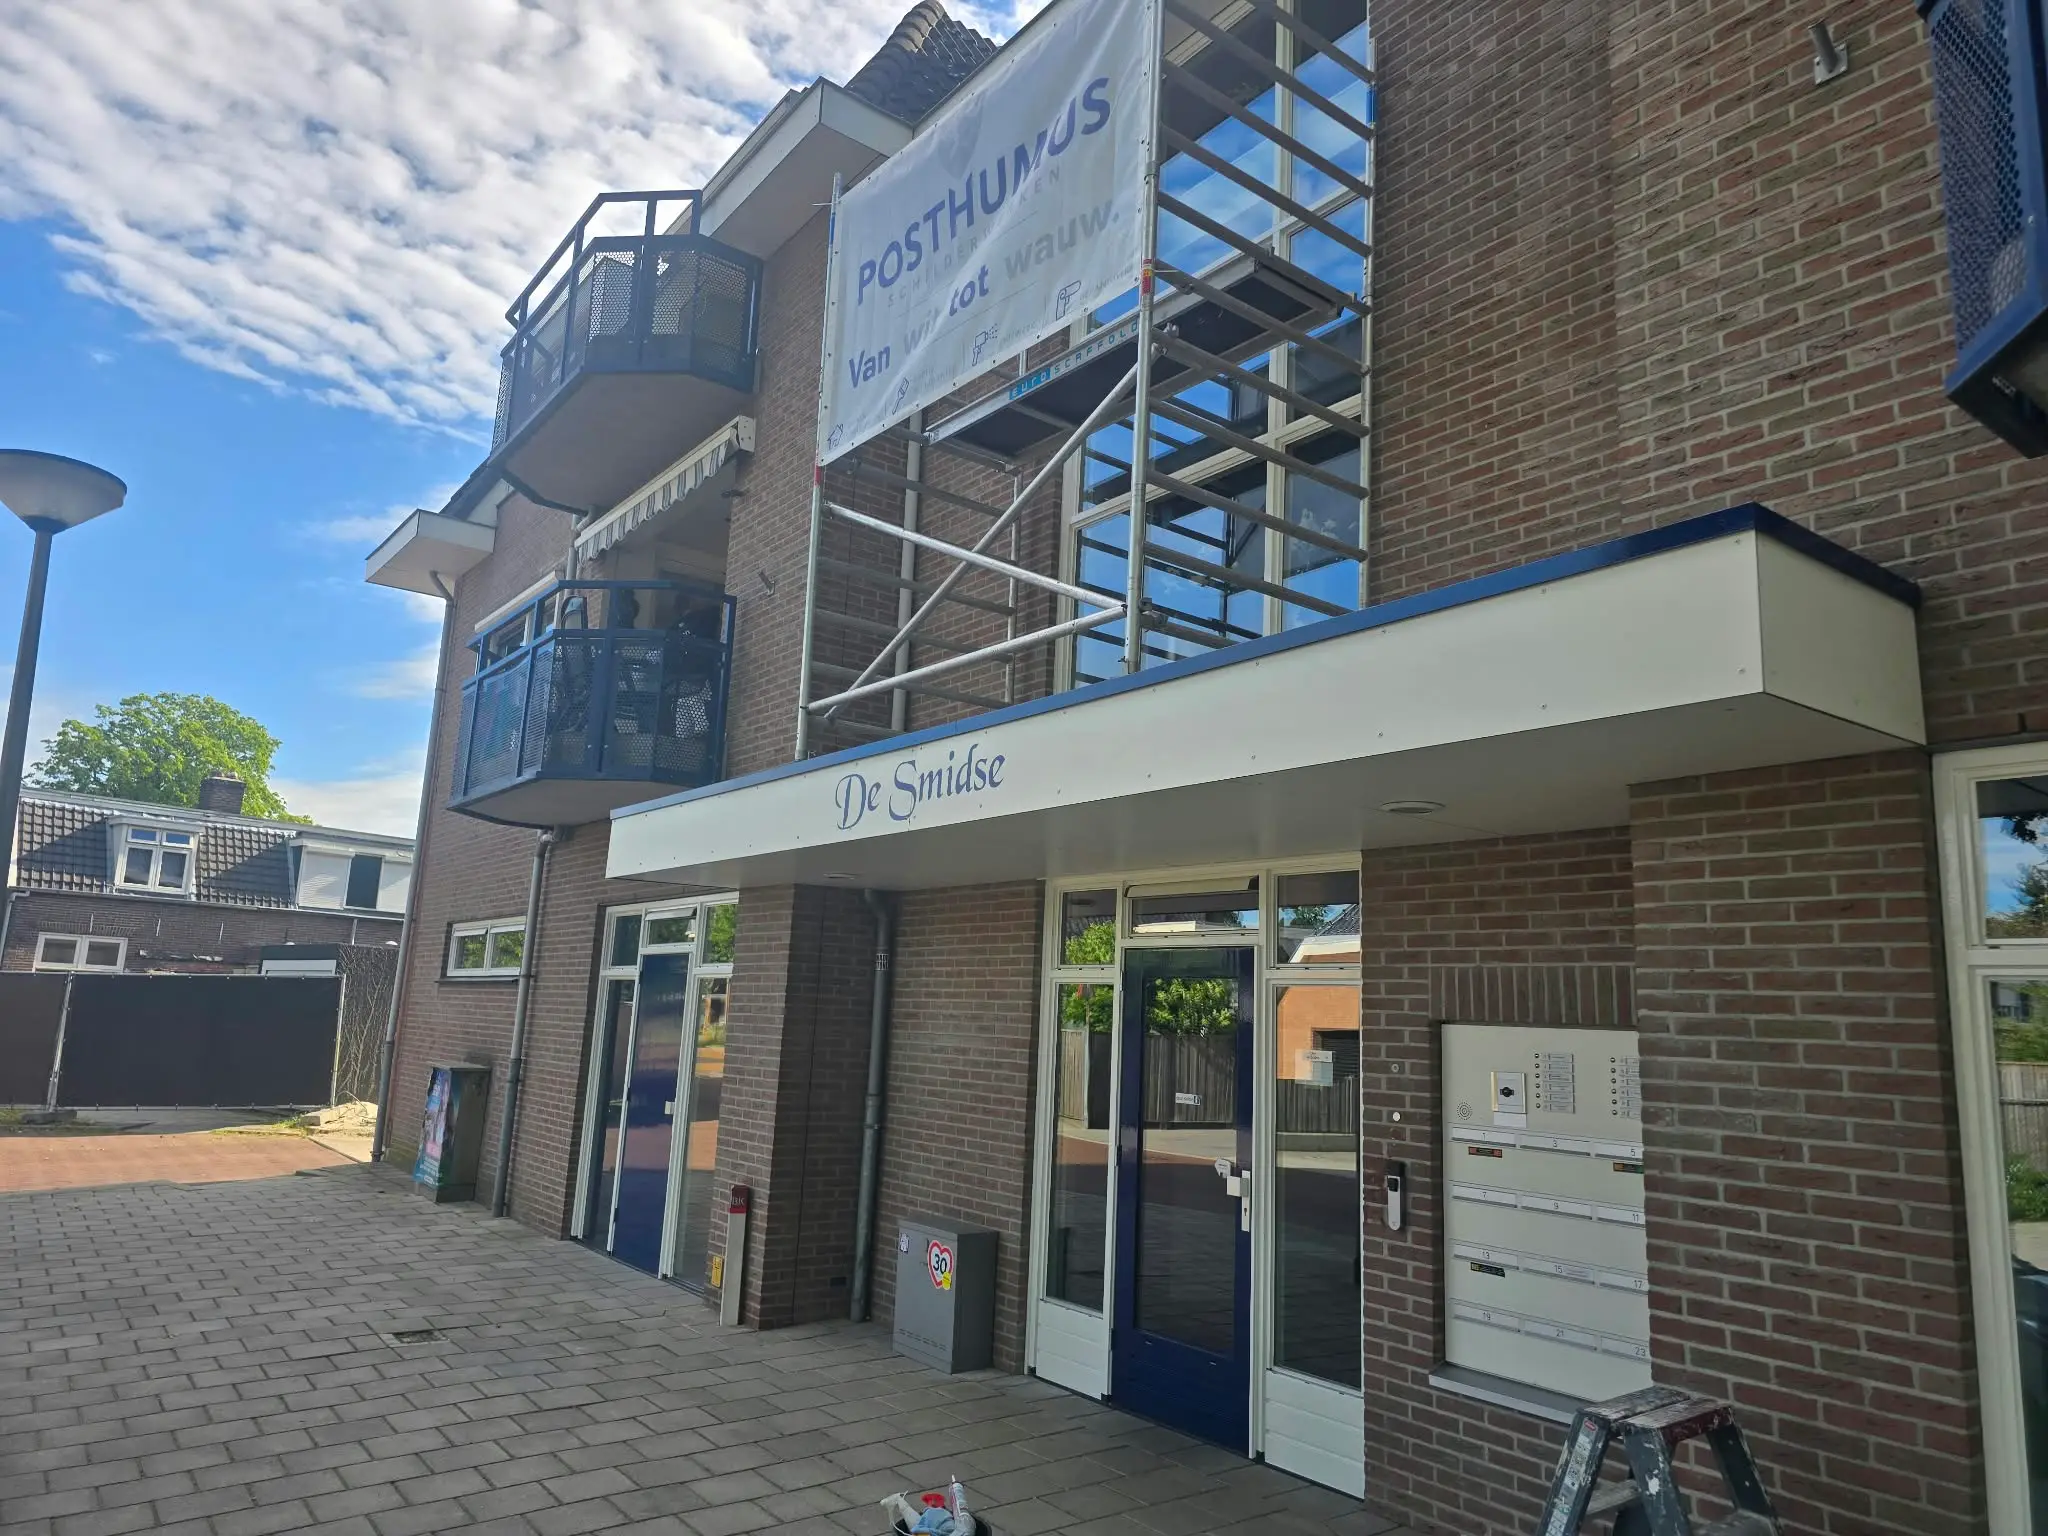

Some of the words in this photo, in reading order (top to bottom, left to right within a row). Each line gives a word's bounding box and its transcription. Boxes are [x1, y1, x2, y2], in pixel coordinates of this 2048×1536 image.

[858, 77, 1111, 305] POSTHUMUS
[849, 345, 891, 389] Van
[949, 264, 990, 317] tot
[1004, 200, 1120, 281] wauw.
[1053, 318, 1138, 375] SCAFFOLD
[835, 773, 882, 830] De
[888, 743, 1006, 821] Smidse
[1552, 1139, 1558, 1148] 3
[1630, 1148, 1636, 1157] 5
[1553, 1202, 1559, 1210] 9
[1632, 1213, 1640, 1222] 11
[933, 1253, 948, 1274] 30
[1482, 1251, 1490, 1260] 13
[1554, 1265, 1563, 1274] 15
[1634, 1280, 1643, 1289] 17
[1482, 1312, 1491, 1321] 19
[1556, 1329, 1564, 1338] 21
[1635, 1347, 1646, 1357] 23
